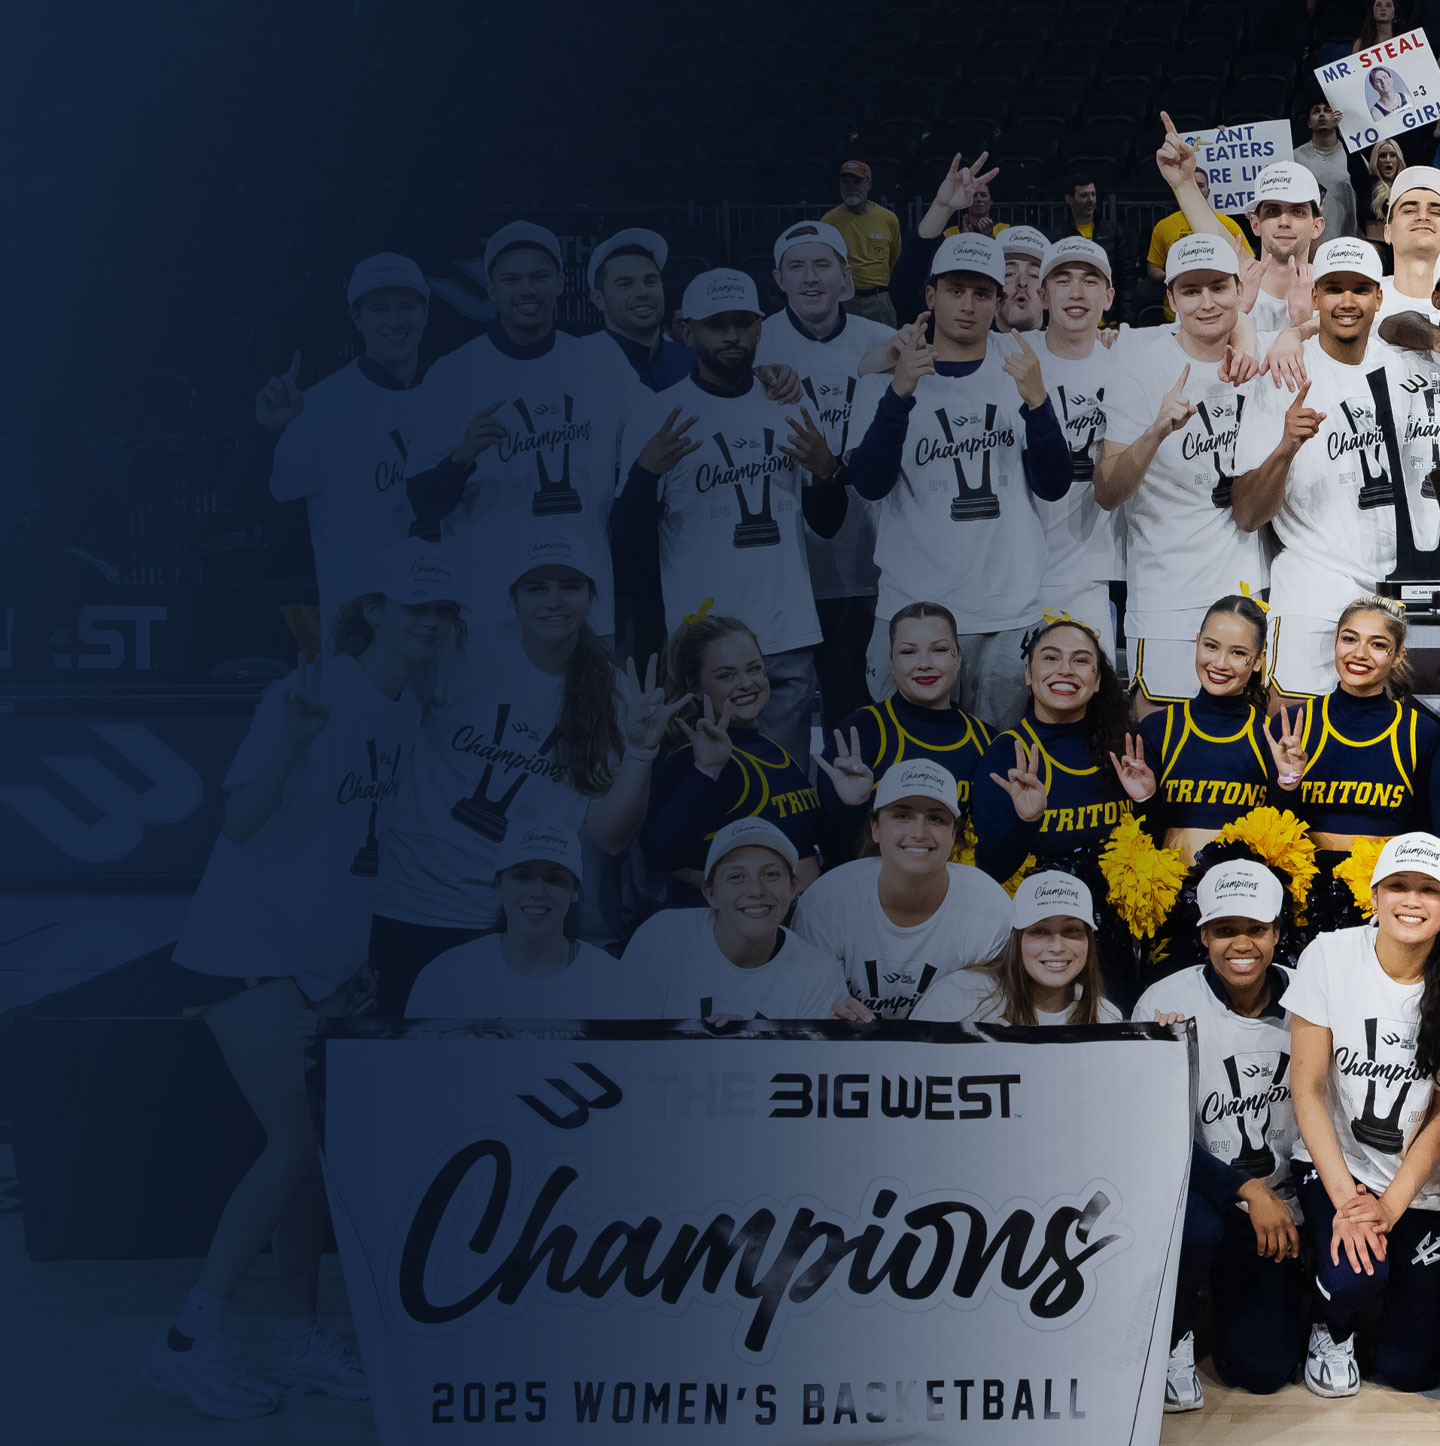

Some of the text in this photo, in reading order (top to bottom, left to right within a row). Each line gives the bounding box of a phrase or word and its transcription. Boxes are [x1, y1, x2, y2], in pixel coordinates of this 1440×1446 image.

[1322, 62, 1355, 84] MR.
[1359, 33, 1424, 68] STEAL
[1215, 126, 1254, 144] ANT
[1350, 127, 1379, 149] YO
[1206, 141, 1275, 162] EATERS
[1210, 167, 1232, 184] RE
[1177, 247, 1215, 260] Champions
[1327, 249, 1364, 260] Champions
[914, 426, 1015, 467] Champions
[696, 454, 795, 494] Champions
[1194, 473, 1212, 485] 24
[1339, 472, 1358, 484] 24
[929, 480, 948, 491] 24
[451, 725, 570, 783] Champions
[901, 770, 945, 787] Champions
[1165, 779, 1268, 807] TRITONS
[1300, 780, 1405, 808] TRITONS
[1395, 844, 1440, 861] Champions
[1034, 886, 1080, 900] Champions
[1215, 878, 1259, 893] Champions
[767, 1071, 869, 1120] BIG
[879, 1072, 1021, 1121] WEST
[1201, 1084, 1292, 1125] Champion
[1209, 1140, 1230, 1152] 24
[398, 1137, 1122, 1354] Champions
[432, 1378, 1087, 1426] 2025 WOMEN'S BASKETBALL
